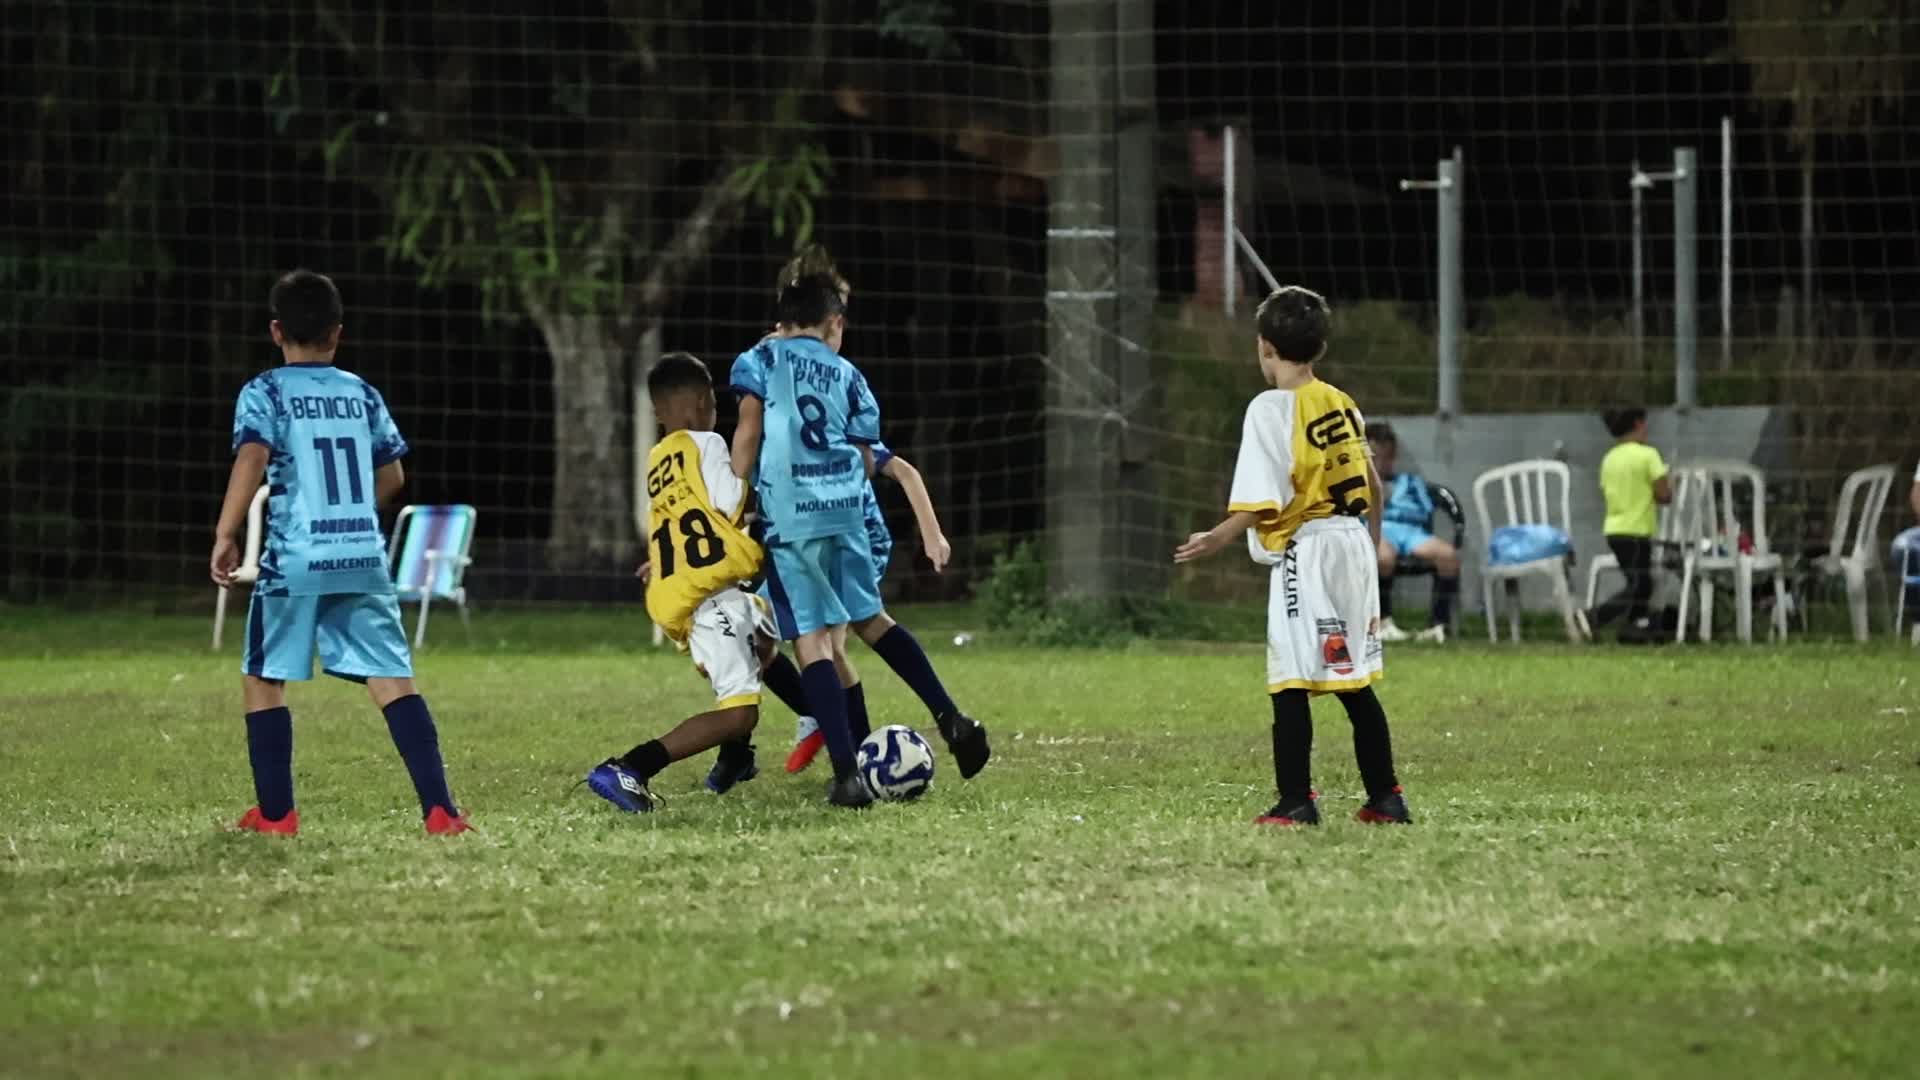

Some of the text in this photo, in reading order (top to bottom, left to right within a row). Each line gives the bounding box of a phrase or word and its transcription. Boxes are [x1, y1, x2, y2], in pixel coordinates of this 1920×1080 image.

[290, 396, 363, 419] BENICIO
[796, 394, 830, 452] 8
[1305, 407, 1361, 451] G21
[312, 436, 365, 506] 11
[647, 450, 685, 499] G21
[651, 507, 728, 581] 18
[1284, 538, 1300, 619] AZZURE
